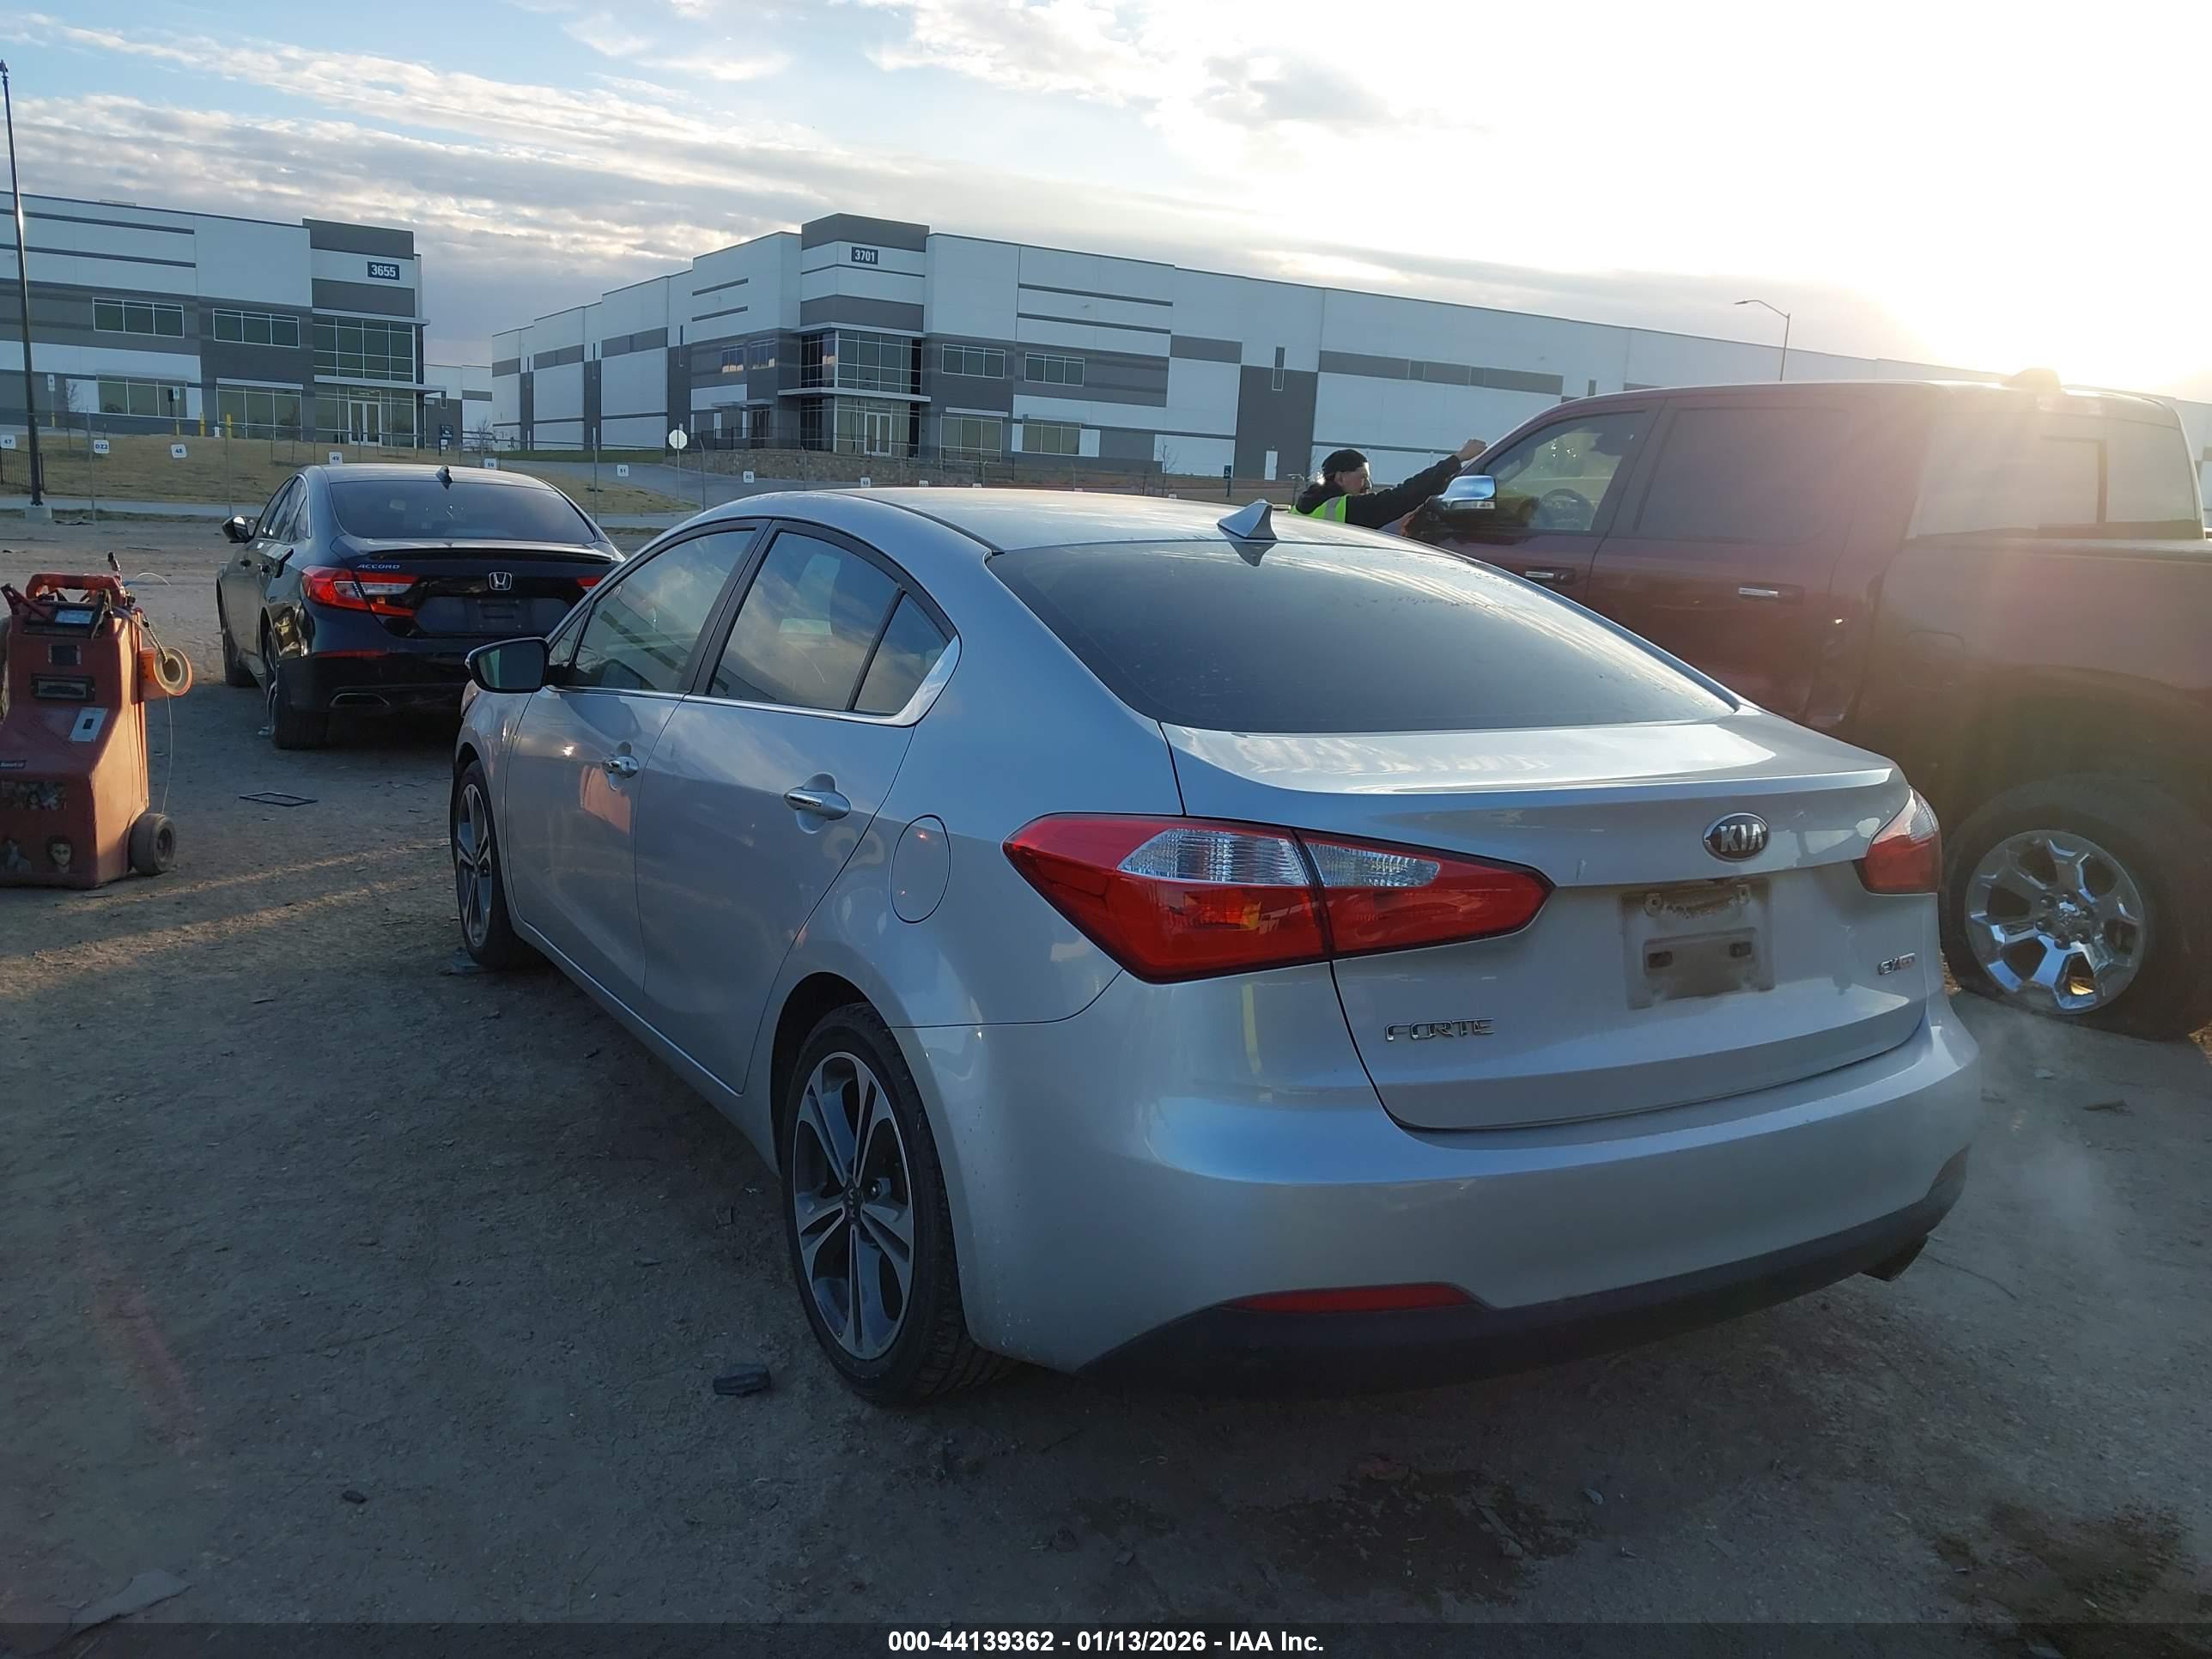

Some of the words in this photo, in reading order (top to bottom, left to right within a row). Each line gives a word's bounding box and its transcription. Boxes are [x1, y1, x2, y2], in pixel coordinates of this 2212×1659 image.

[854, 249, 875, 262] 3701
[371, 264, 396, 276] 3655
[1718, 823, 1767, 853] KIA
[1386, 1018, 1494, 1042] FORTE
